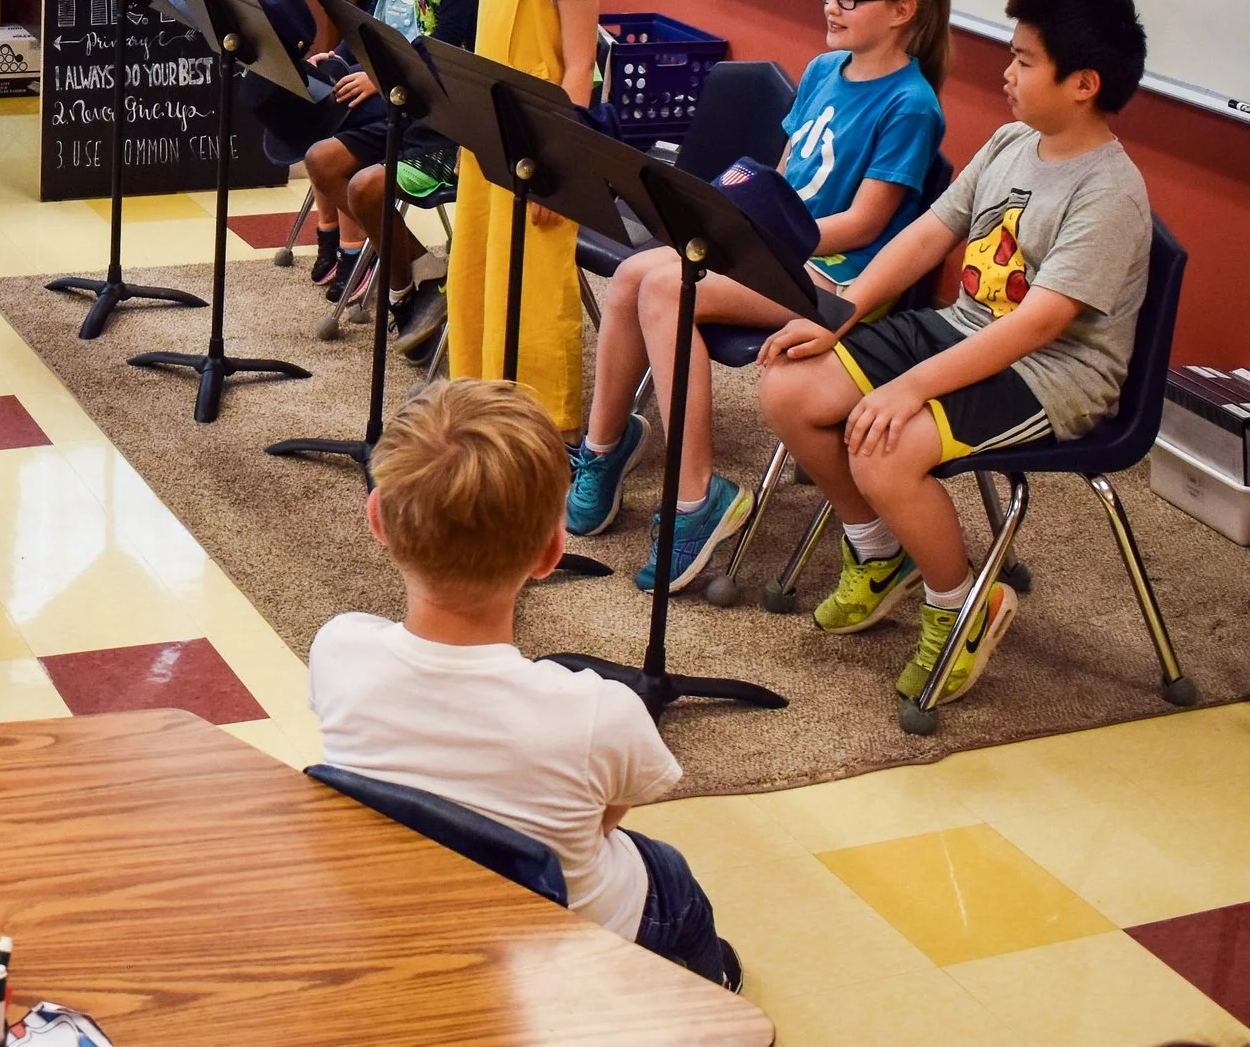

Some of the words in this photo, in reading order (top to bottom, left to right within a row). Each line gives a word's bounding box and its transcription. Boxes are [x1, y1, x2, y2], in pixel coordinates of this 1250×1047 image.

[65, 64, 115, 91] ALWAYS
[142, 61, 177, 87] YOUR
[177, 56, 213, 87] BEST
[73, 140, 102, 167] USE
[123, 137, 180, 166] OMMON
[189, 134, 239, 160] SENE
